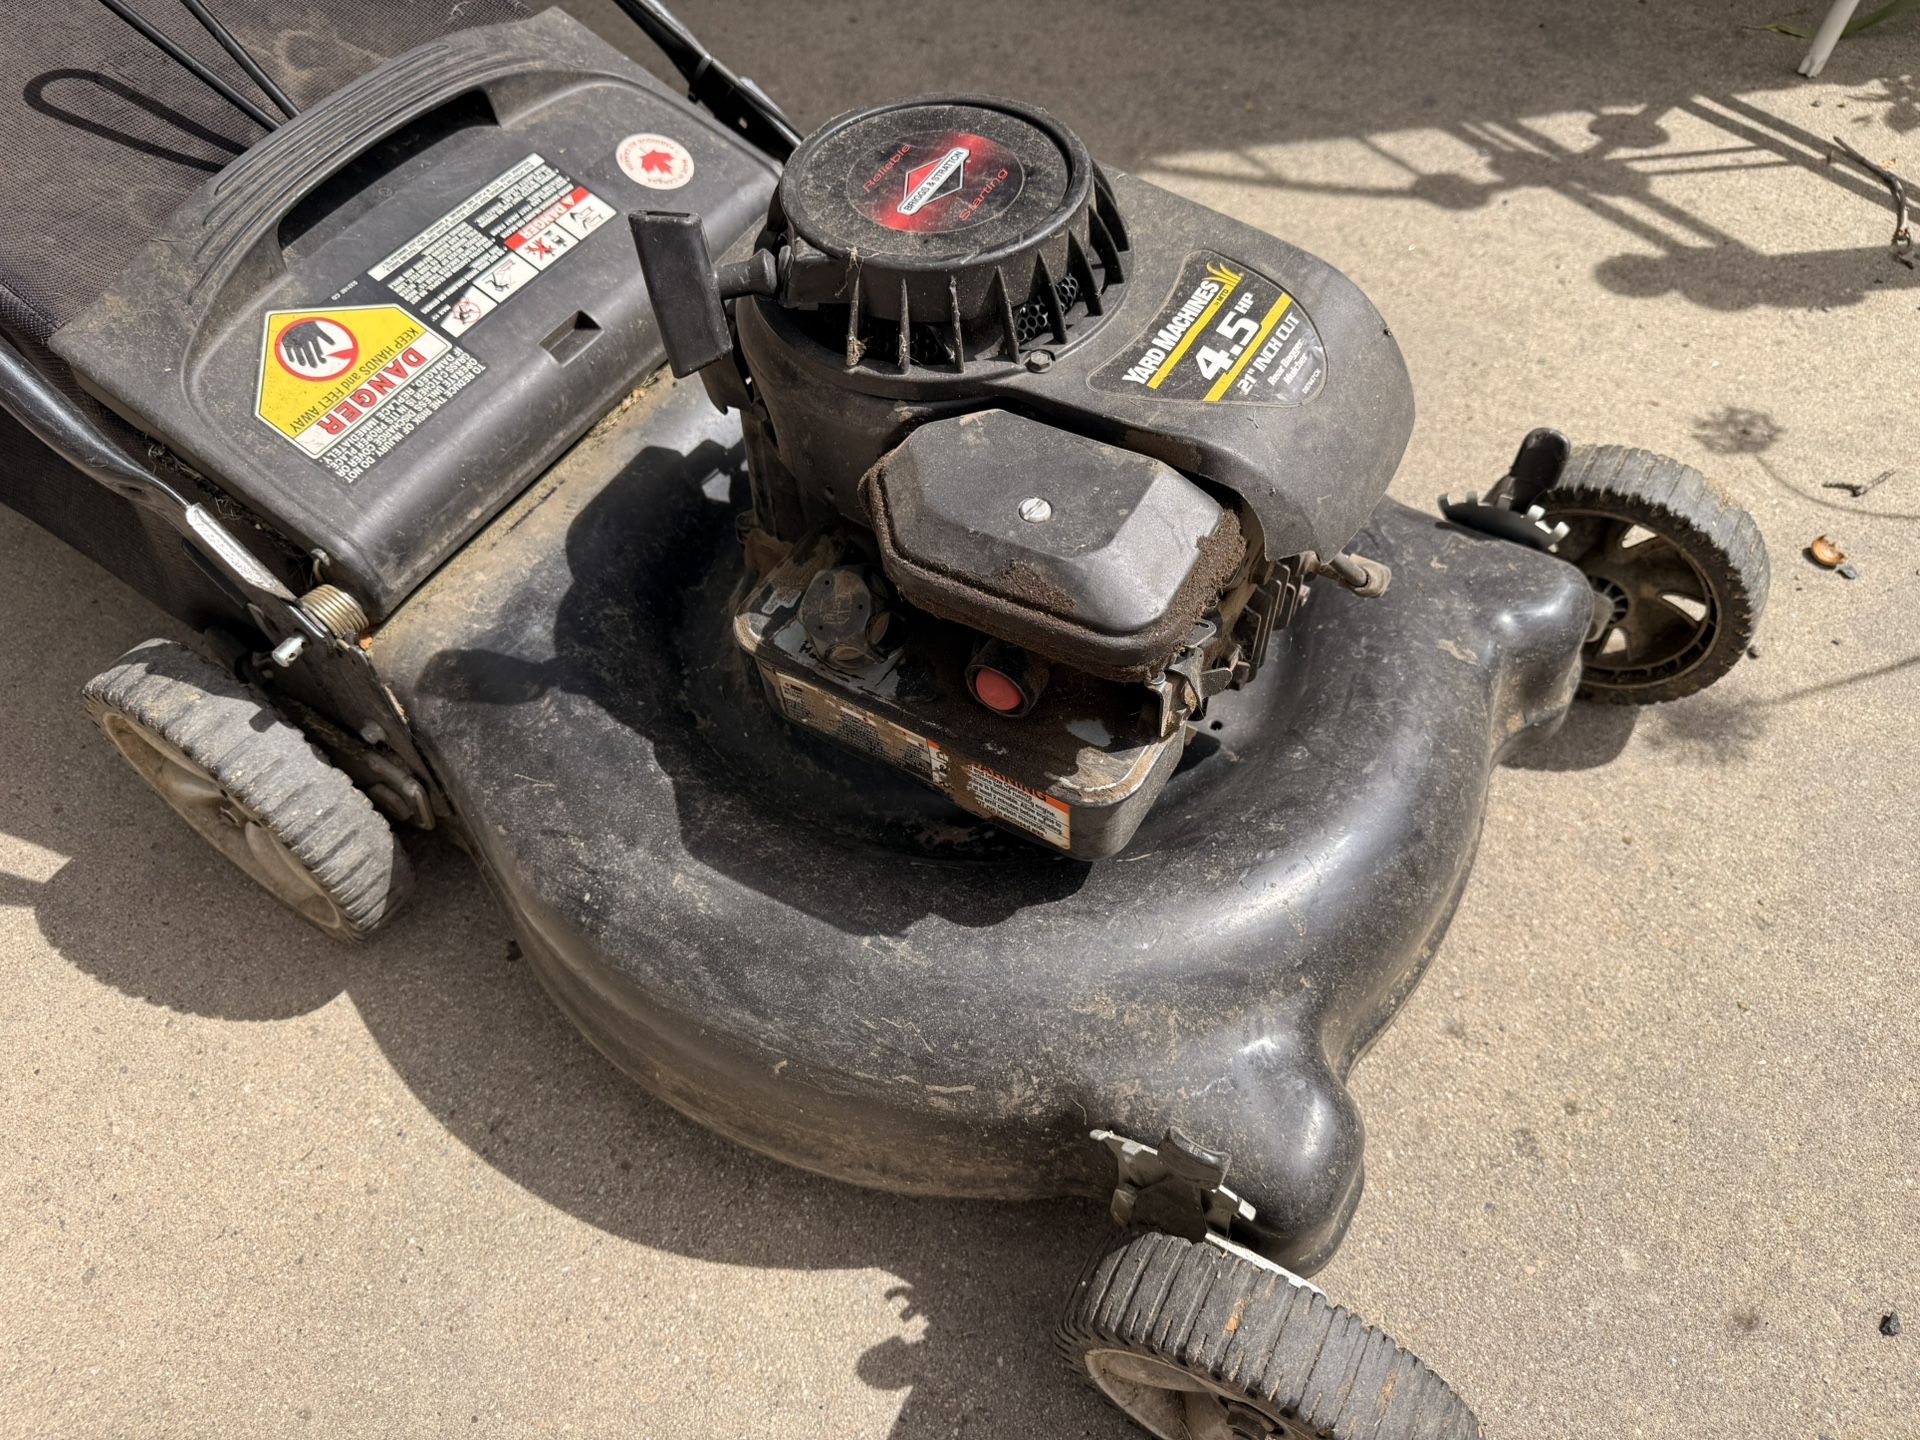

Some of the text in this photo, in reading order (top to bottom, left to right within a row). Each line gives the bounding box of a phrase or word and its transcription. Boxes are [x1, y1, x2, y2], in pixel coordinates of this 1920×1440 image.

[863, 144, 912, 193] Reliable
[904, 151, 964, 212] BRIGGS & STRATTON
[959, 168, 1008, 221] Starting
[516, 201, 567, 240] DANGER
[1217, 288, 1229, 303] MTD
[1122, 281, 1220, 385] YARD MACHINES
[1195, 291, 1262, 381] 4.5 HP
[1236, 312, 1301, 395] 21" INCH CUT
[286, 327, 419, 432] KEEP HANDS and FEET AWAY
[442, 371, 476, 398] REDUCE
[470, 362, 486, 374] TO
[1267, 365, 1285, 386] Rear
[1283, 353, 1308, 384] Mulcher
[313, 346, 428, 437] DANGER
[318, 346, 464, 466] IF DAMAGED, REPLACE IMMEDIATELY.
[326, 351, 471, 471] GRASS CATCHER IS IN ITS PROPER PLACE.
[428, 395, 447, 410] THE
[334, 357, 478, 477] OPERATE UNLESS DISCHARGE COVER OR
[399, 422, 415, 434] OF
[410, 407, 433, 425] RISK
[342, 465, 364, 482] NOT
[359, 455, 376, 468] DO
